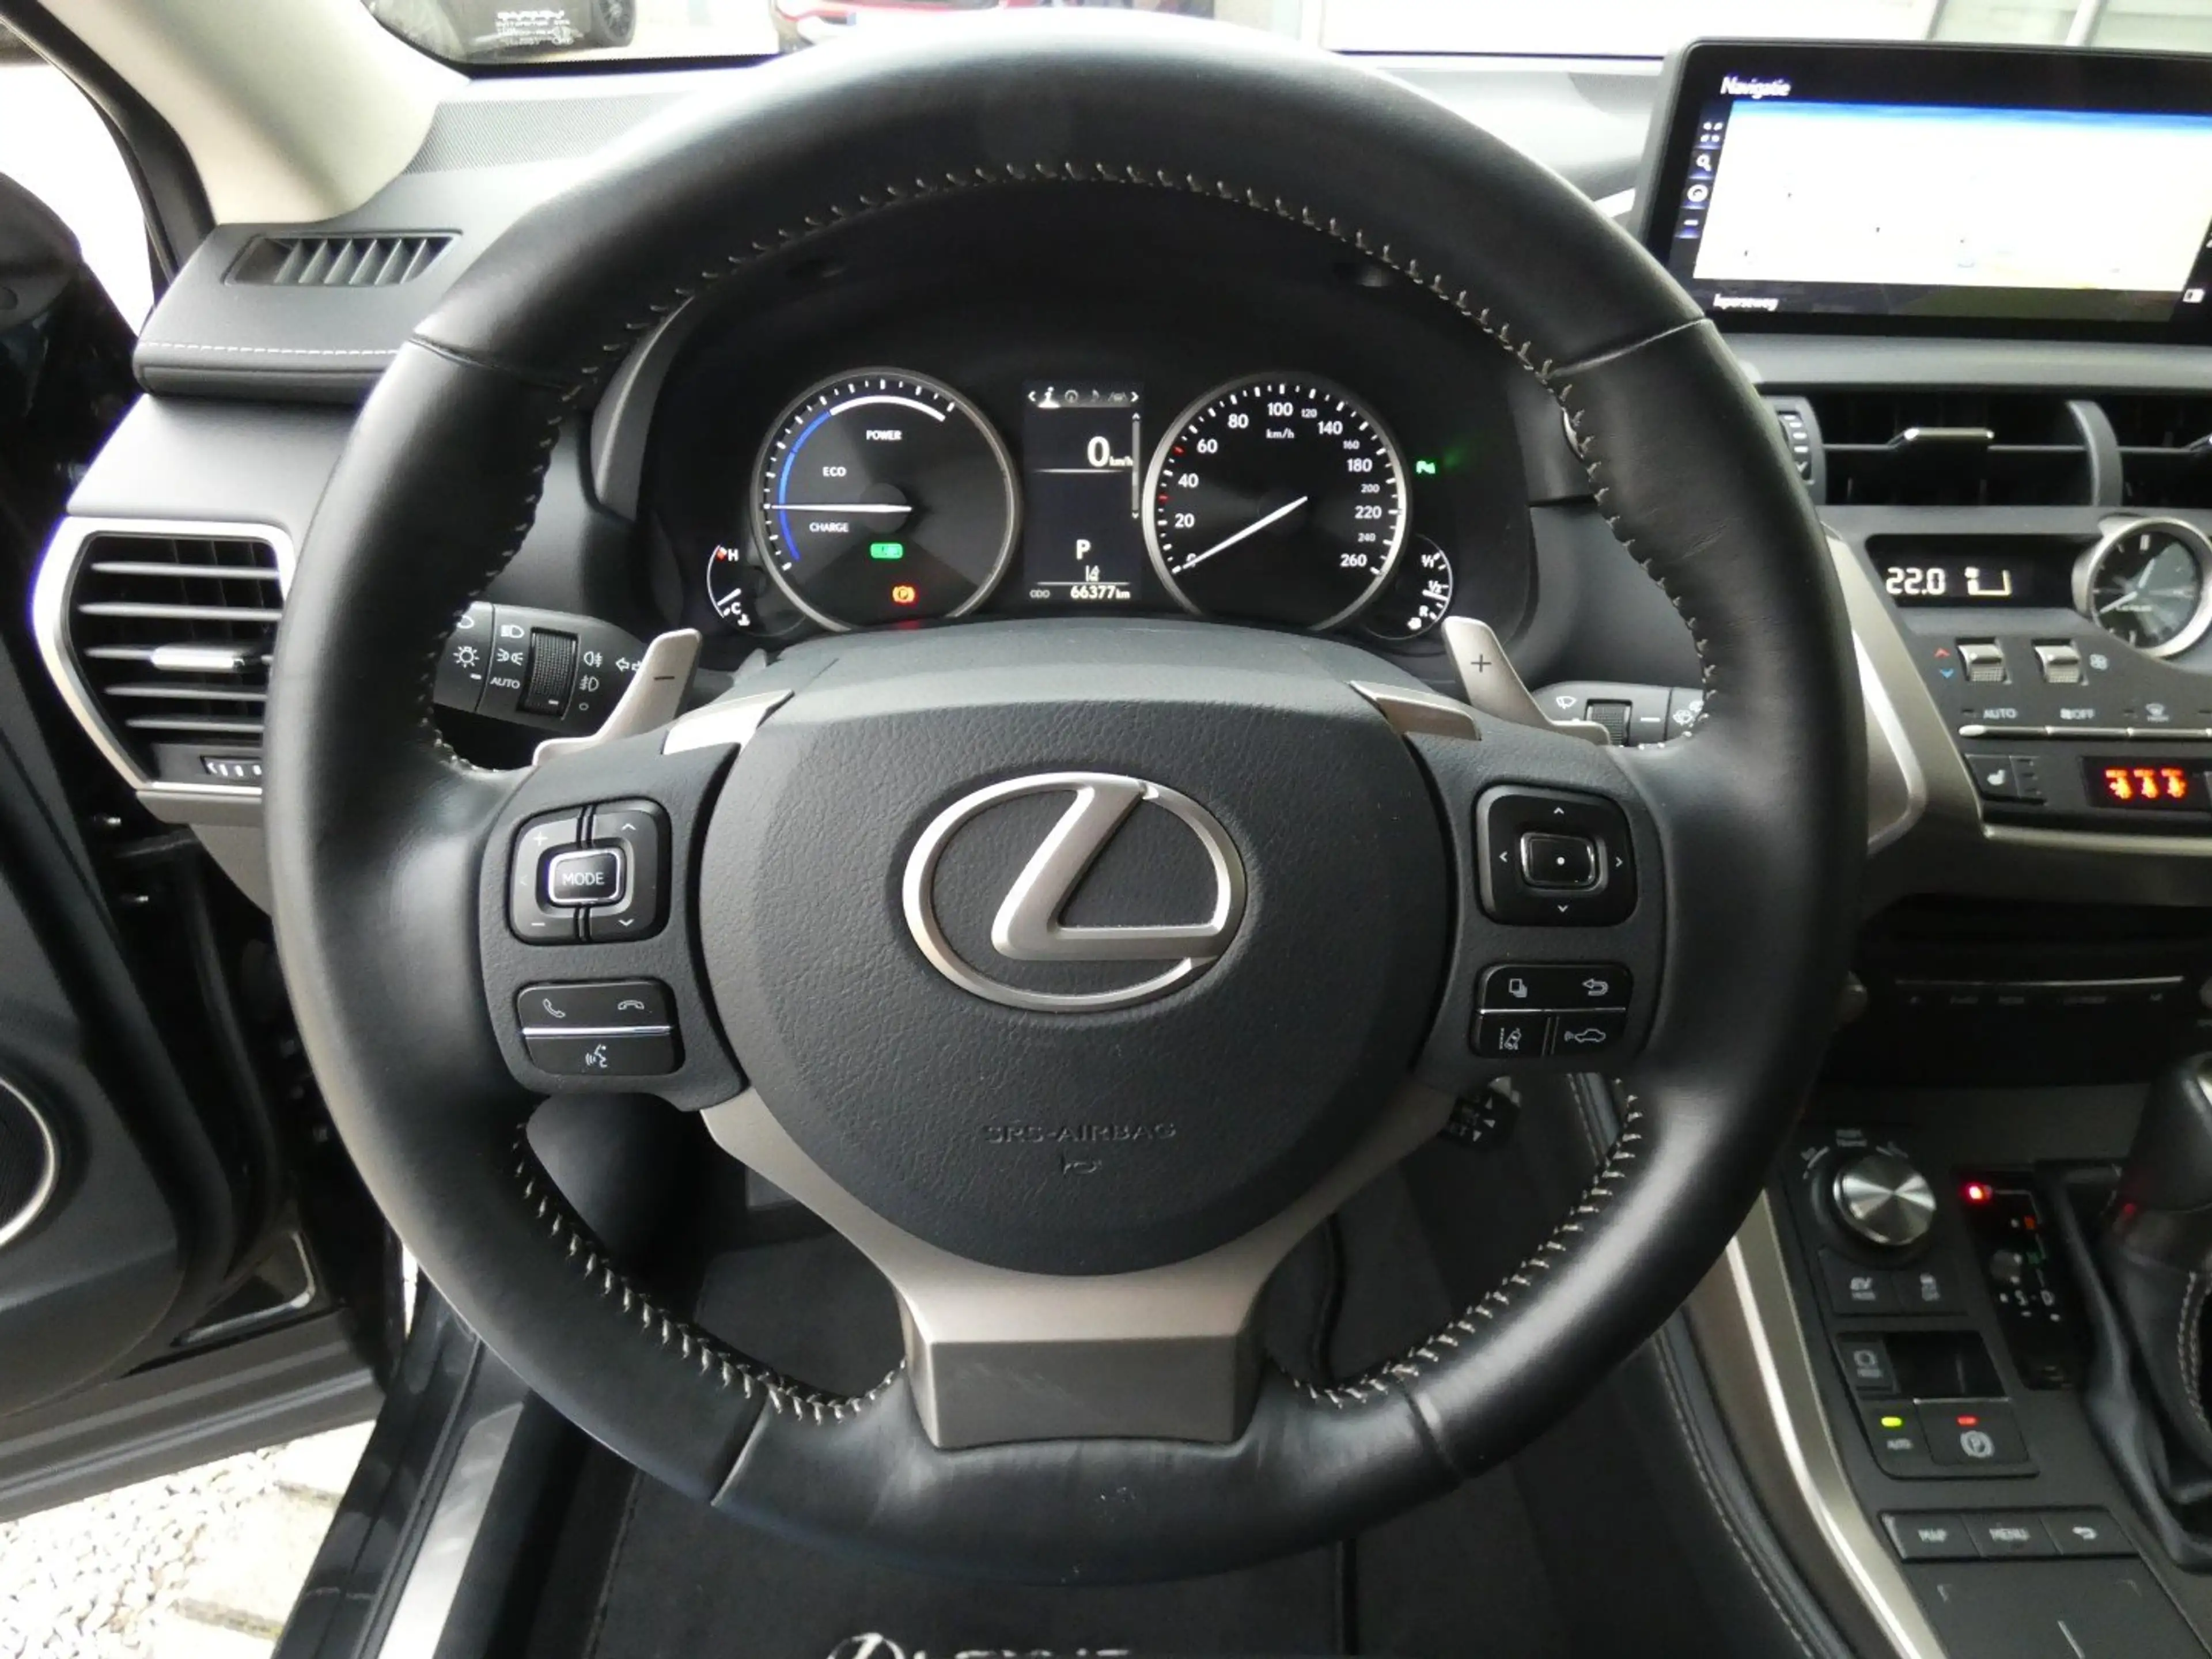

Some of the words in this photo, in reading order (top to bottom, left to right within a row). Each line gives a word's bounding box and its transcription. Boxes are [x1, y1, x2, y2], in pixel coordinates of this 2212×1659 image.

[1721, 76, 1791, 99] Navigatie
[1268, 402, 1293, 416] 100
[1301, 408, 1317, 418] 120
[1228, 413, 1249, 429] 80
[1318, 421, 1343, 435] 140
[866, 430, 902, 441] POWER
[1266, 428, 1294, 439] km/h
[1197, 439, 1218, 453] 60
[1343, 440, 1359, 450] 160
[822, 466, 847, 477] ECO
[1347, 458, 1372, 472] 180
[1178, 474, 1199, 488] 40
[1361, 483, 1380, 494] 200
[1354, 506, 1382, 520] 220
[809, 522, 849, 533] CHARGE
[1175, 513, 1195, 528] 20
[1358, 532, 1376, 543] 240
[728, 548, 739, 562] H
[1076, 539, 1091, 560] P
[1340, 553, 1368, 567] 260
[1885, 567, 1946, 596] 22.0
[1029, 589, 1051, 599] ODO
[731, 601, 741, 615] C
[1419, 605, 1429, 618] R
[490, 676, 521, 690] AUTO
[1983, 708, 2017, 719] AUTO
[562, 871, 605, 886] MODE
